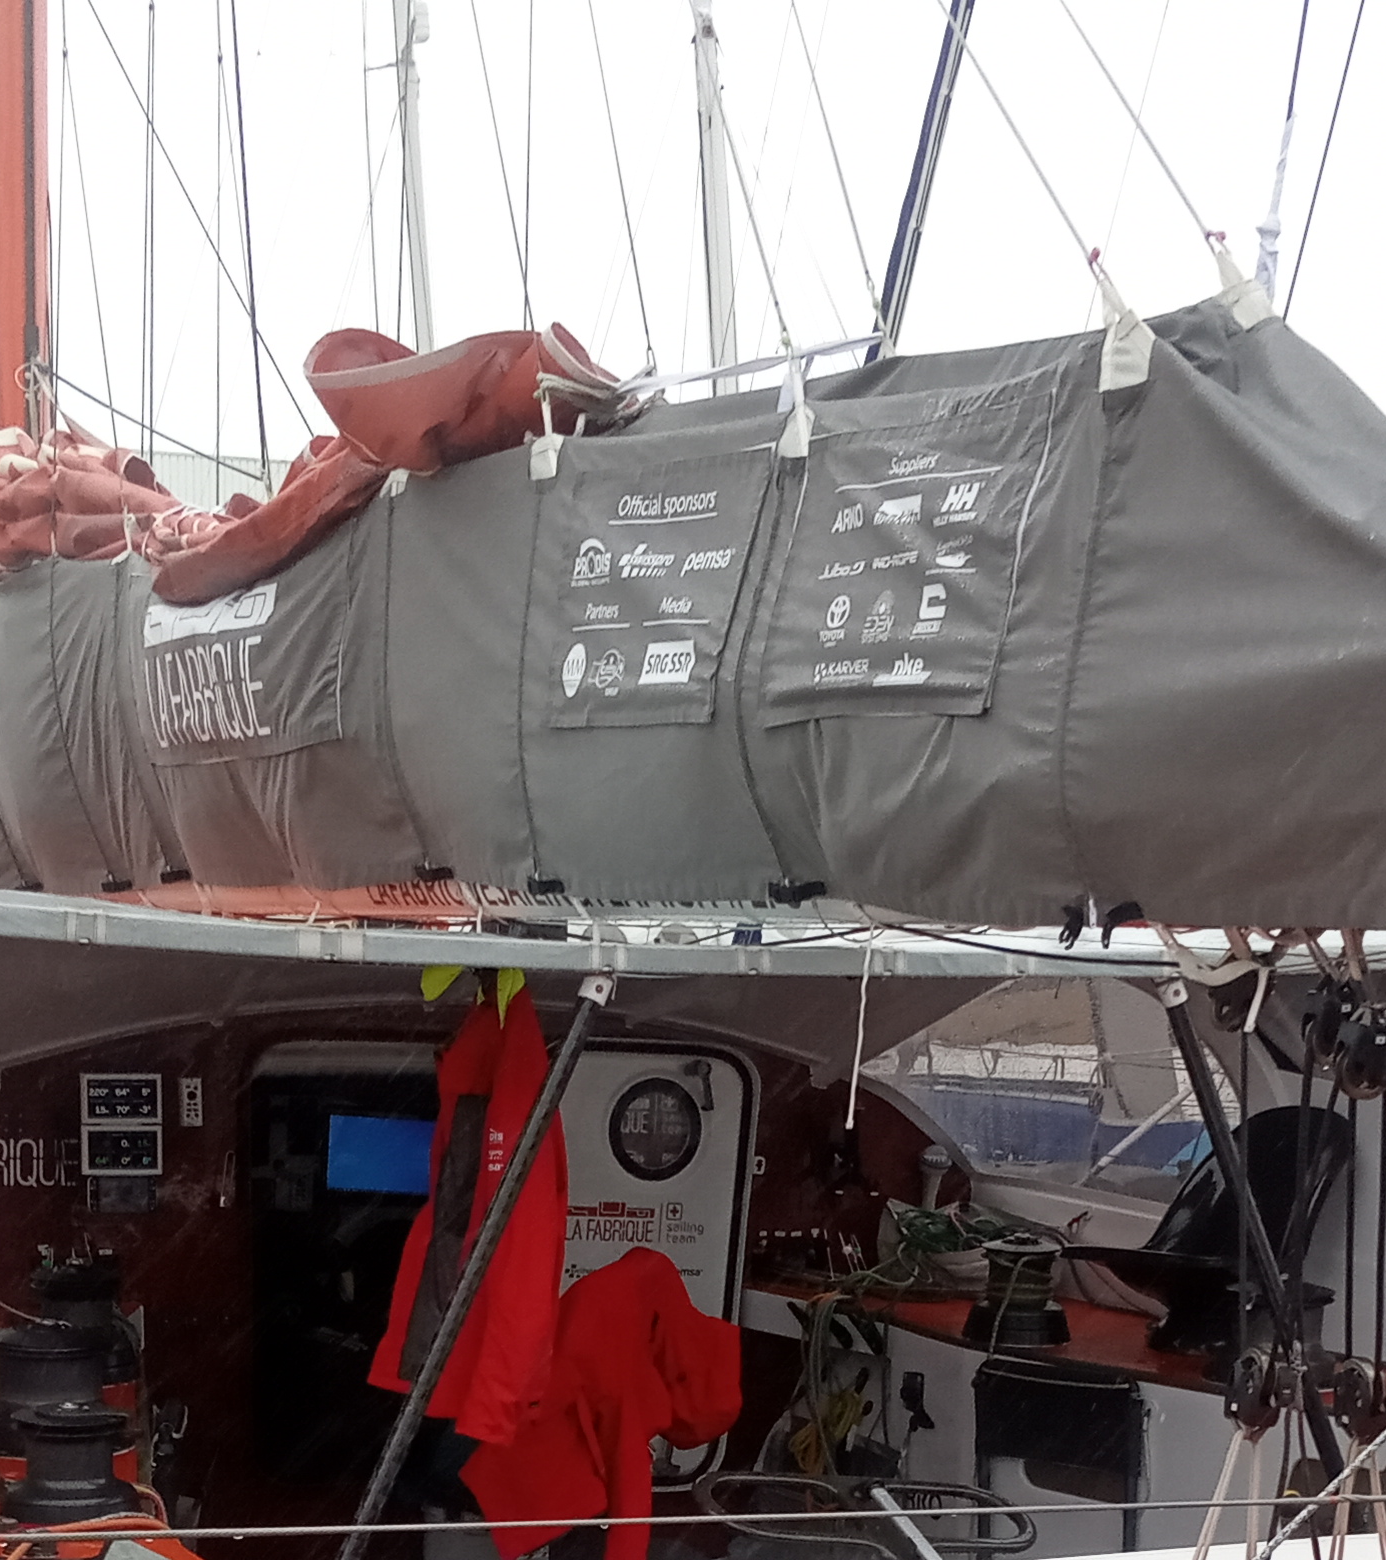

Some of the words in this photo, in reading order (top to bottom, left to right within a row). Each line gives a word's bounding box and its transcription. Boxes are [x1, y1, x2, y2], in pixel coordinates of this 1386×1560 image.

[889, 451, 939, 475] Suppliers
[618, 493, 661, 517] Official
[663, 491, 717, 519] sponsors
[831, 503, 862, 533] ARKO
[680, 548, 732, 577] pemsa
[585, 603, 619, 619] Partners
[659, 597, 692, 613] Media
[828, 658, 869, 675] KARVER
[893, 652, 924, 675] nke
[586, 1219, 654, 1243] FABRIQUE
[666, 1233, 697, 1244] team
[667, 1222, 704, 1235] sailing
